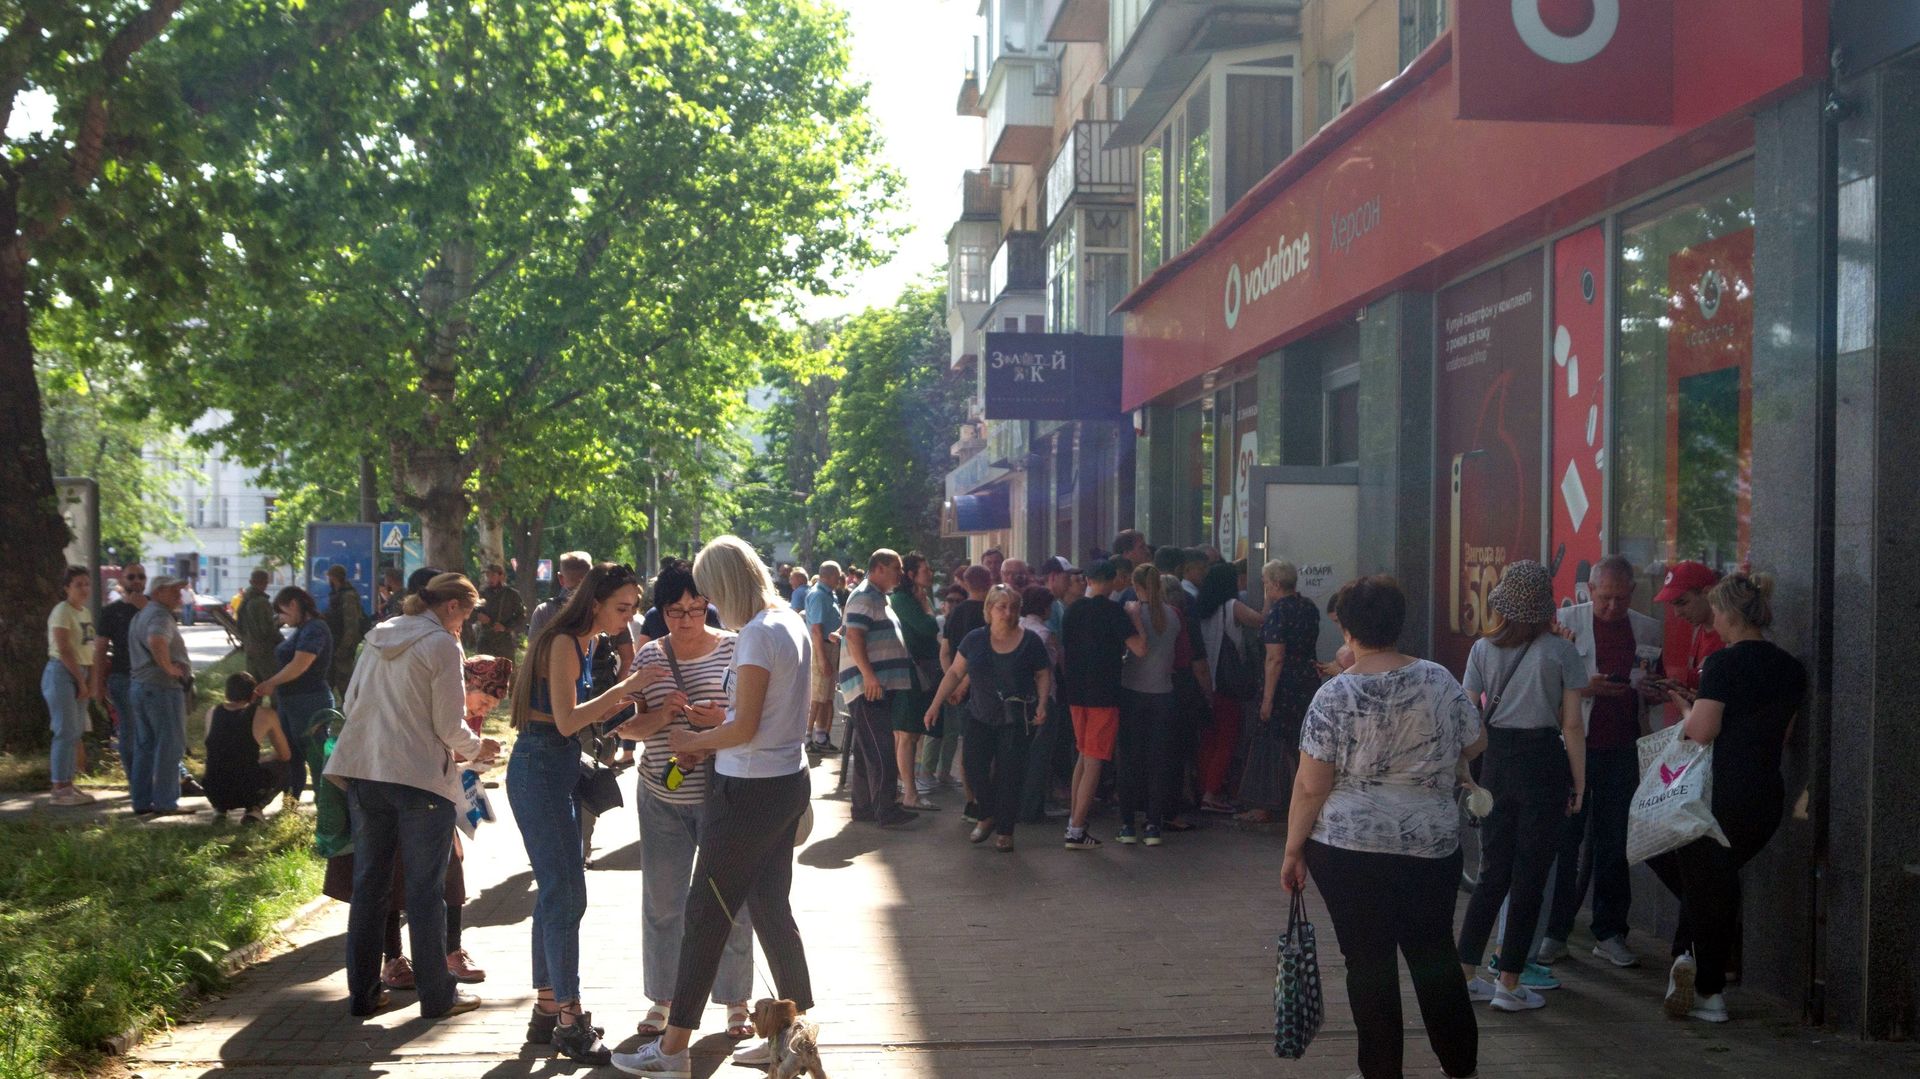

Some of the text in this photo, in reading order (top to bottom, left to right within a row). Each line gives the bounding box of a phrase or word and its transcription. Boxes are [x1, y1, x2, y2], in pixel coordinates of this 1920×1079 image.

[1330, 195, 1381, 255] Херсон
[1244, 231, 1310, 304] vodafone
[1464, 543, 1506, 565] Вигода до
[1463, 564, 1508, 637] 50
